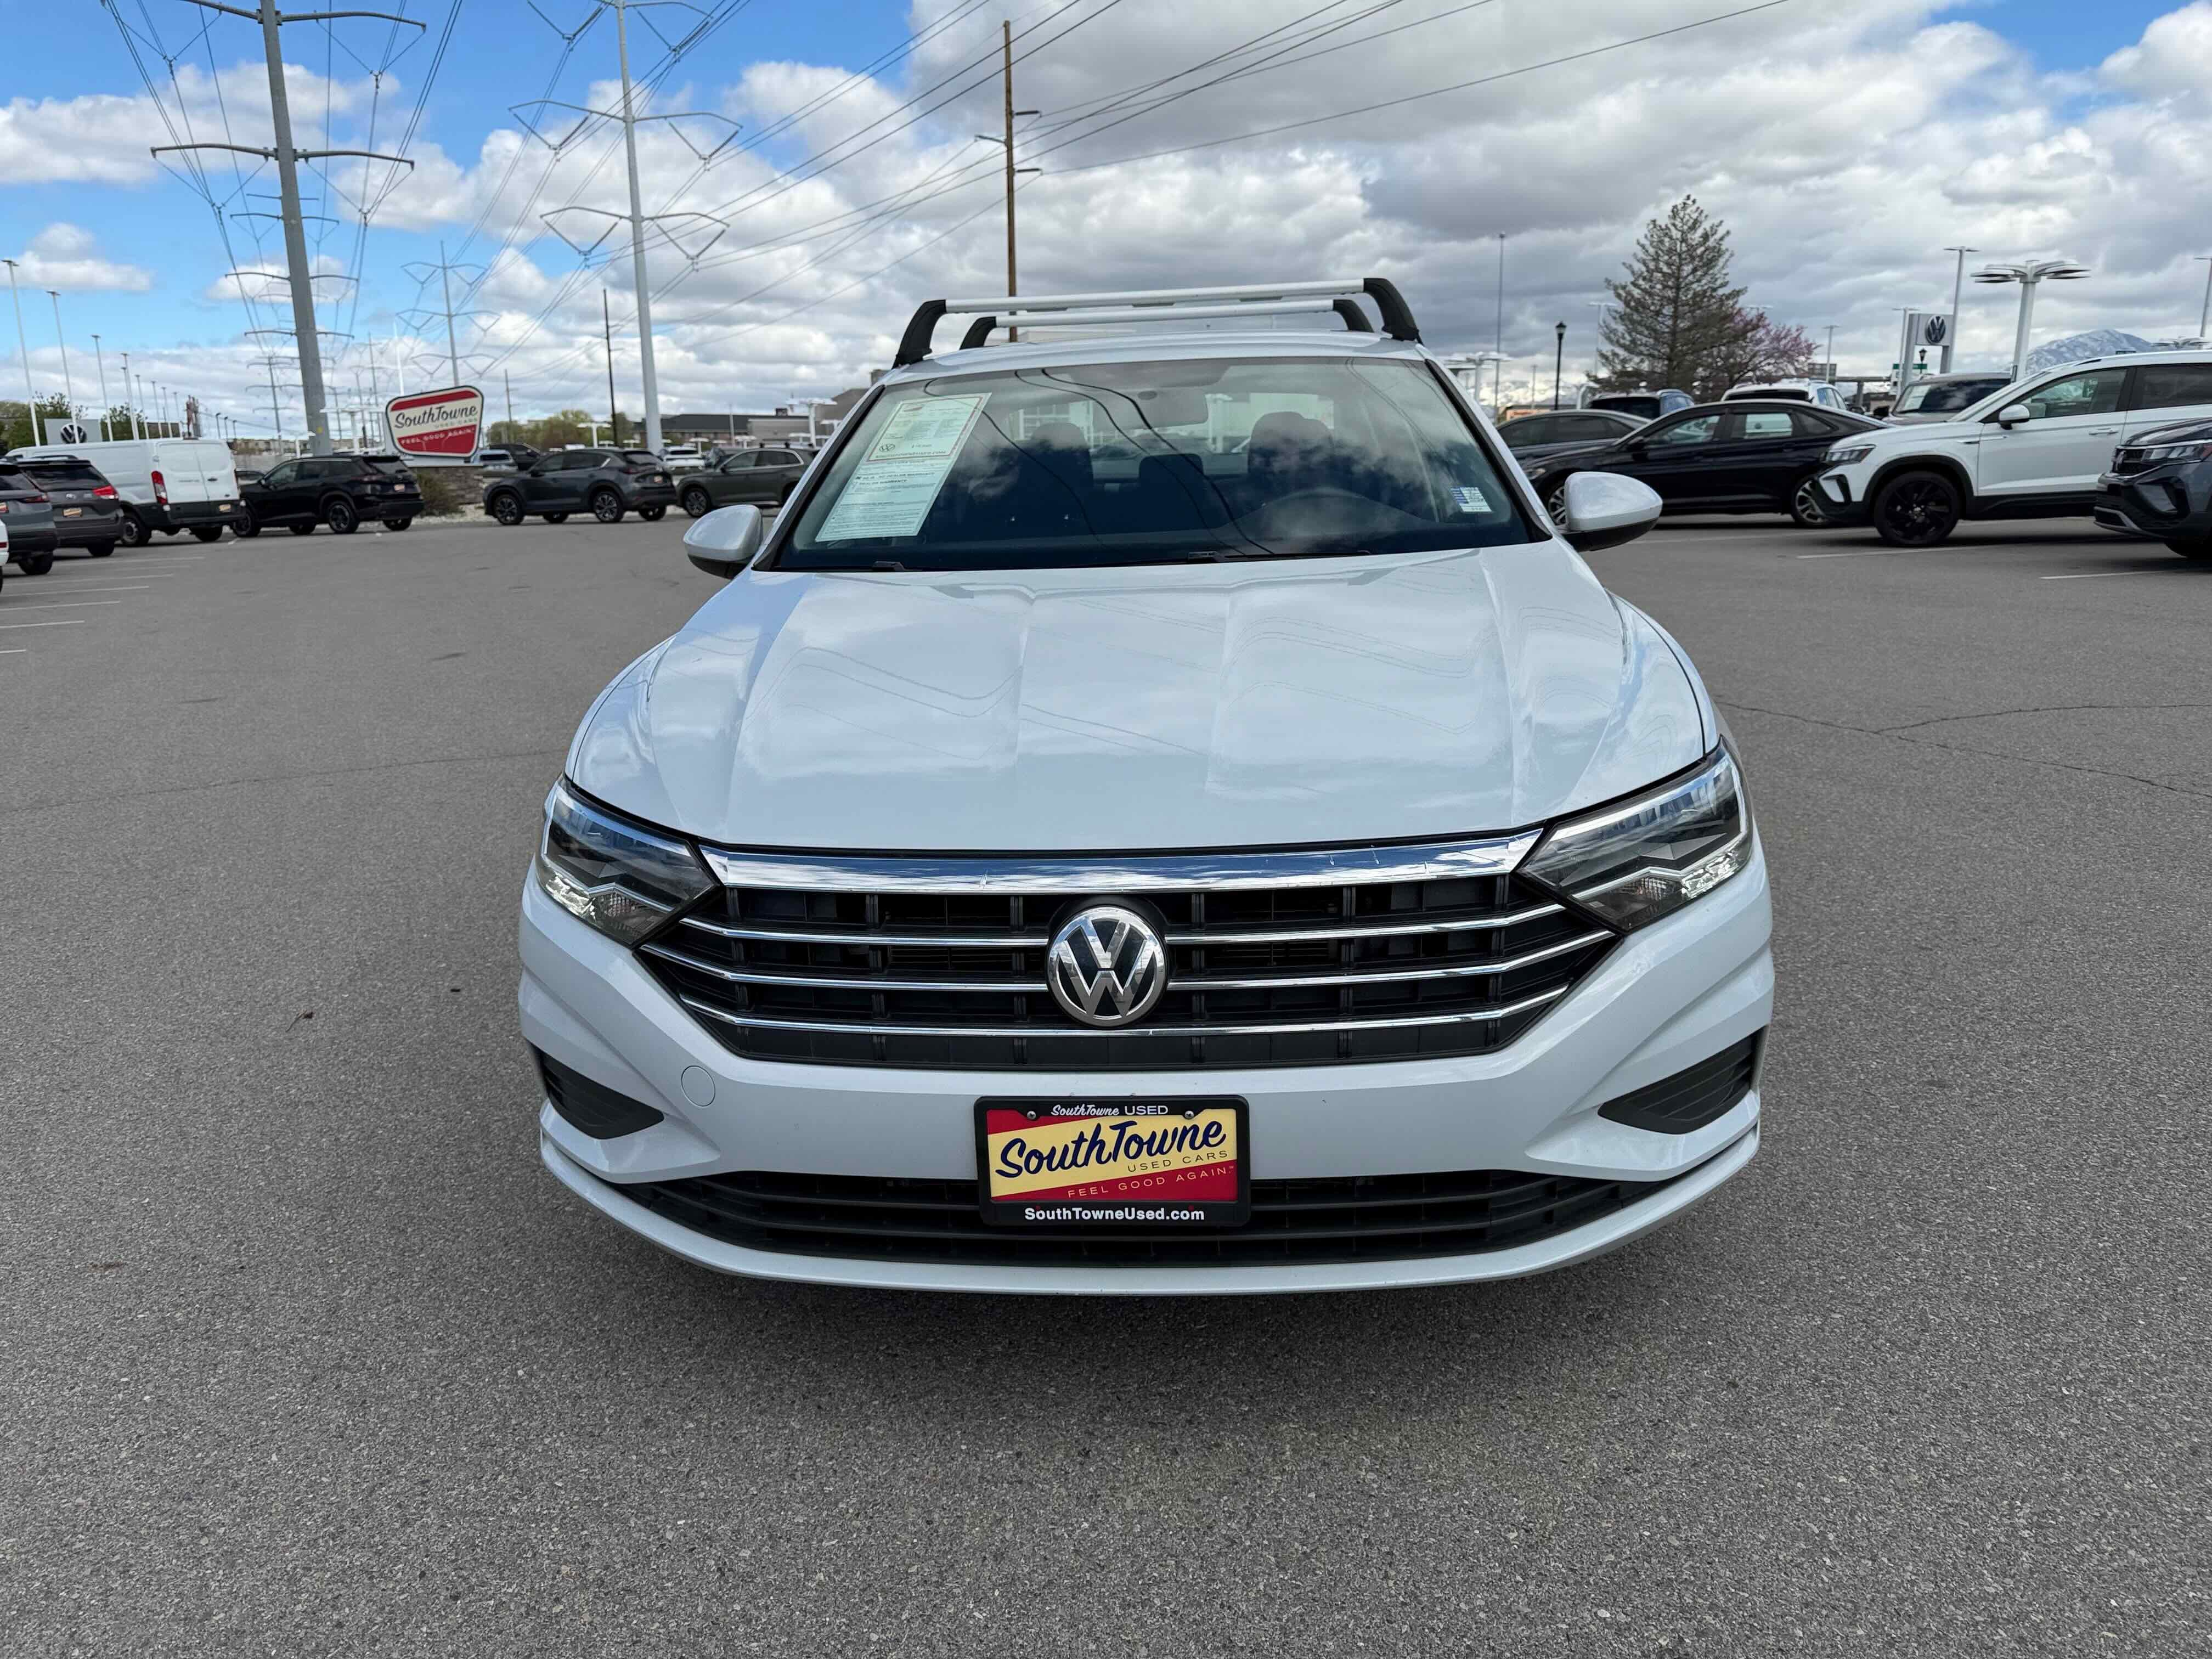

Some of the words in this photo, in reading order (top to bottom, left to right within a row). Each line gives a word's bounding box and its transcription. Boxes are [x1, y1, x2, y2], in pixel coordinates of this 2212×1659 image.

[395, 405, 478, 428] SouthTowne
[1051, 1104, 1120, 1116] SouthTowne
[1125, 1105, 1169, 1115] USED
[995, 1120, 1226, 1178] SouthTowne
[1128, 1159, 1171, 1172] USED
[1182, 1150, 1228, 1164] CARS
[1068, 1186, 1109, 1198] FEEL
[1118, 1177, 1165, 1190] GOOD
[1024, 1207, 1205, 1220] SouthTowneUsed.com
